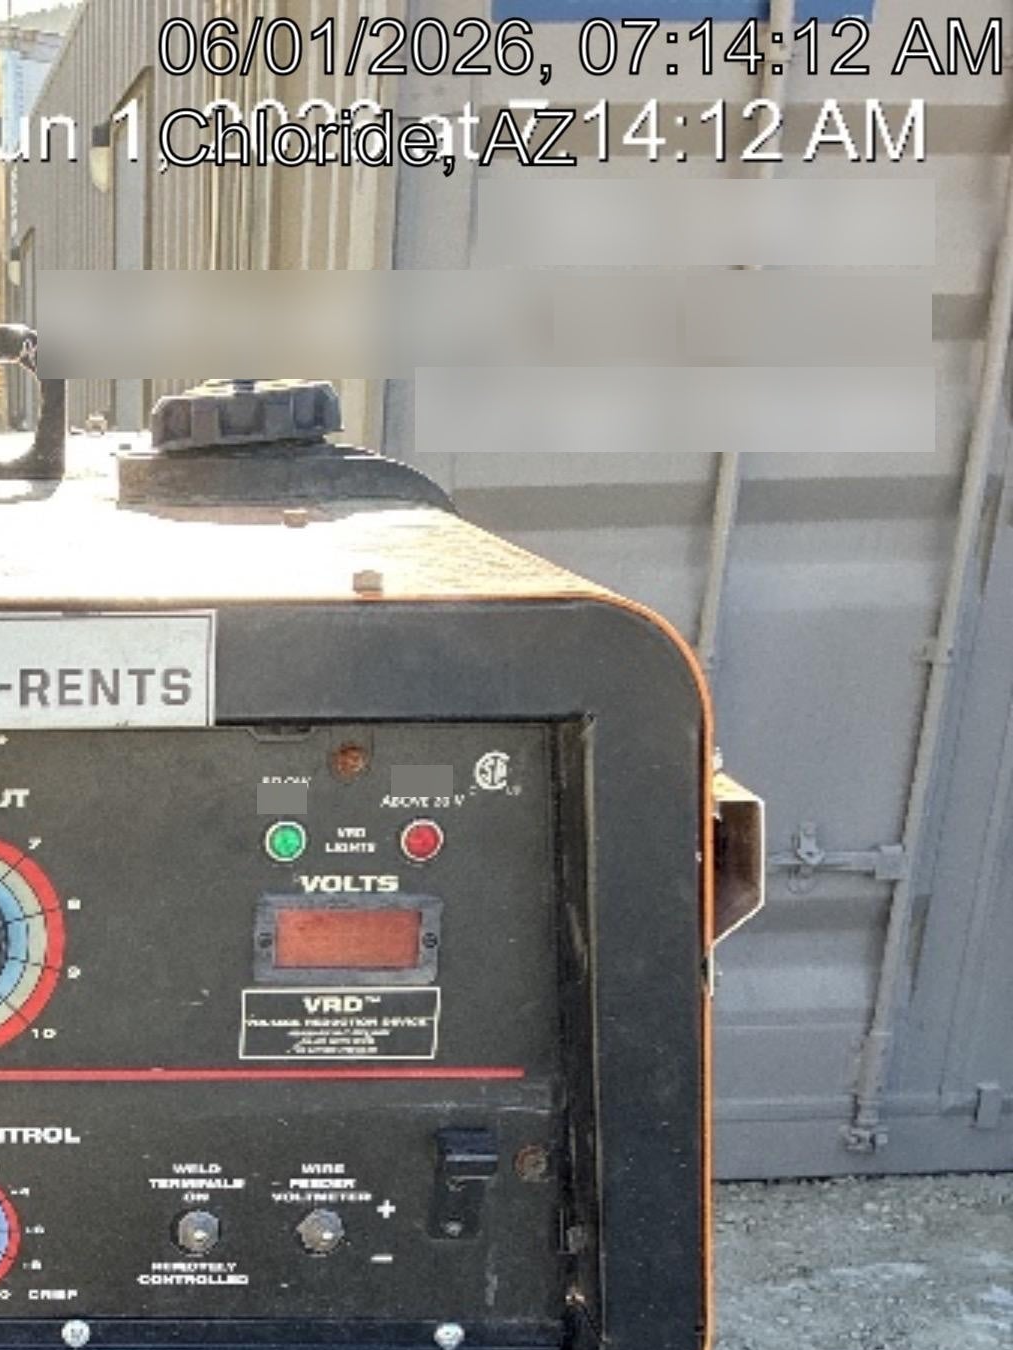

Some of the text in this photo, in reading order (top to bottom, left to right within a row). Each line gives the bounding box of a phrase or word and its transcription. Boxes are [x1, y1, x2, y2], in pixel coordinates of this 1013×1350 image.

[298, 874, 400, 893] VOLTS
[172, 1162, 223, 1175] WELD
[136, 1274, 249, 1286] CONTROLLED
